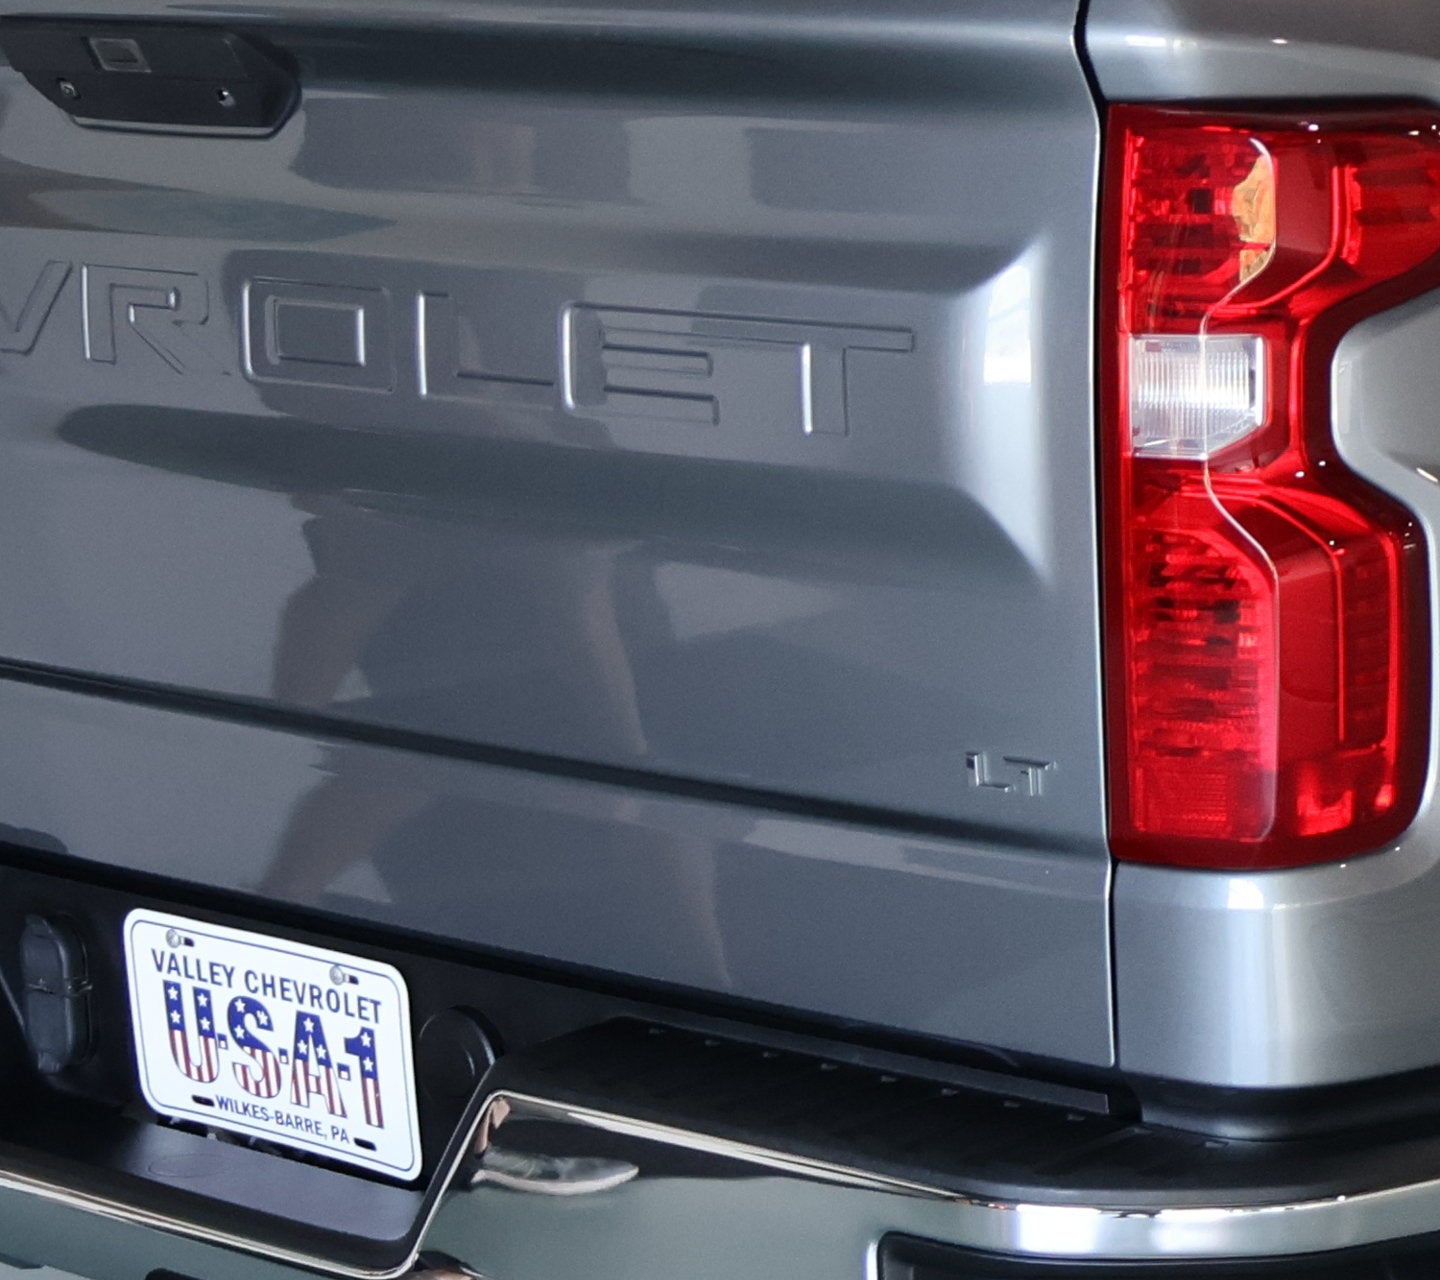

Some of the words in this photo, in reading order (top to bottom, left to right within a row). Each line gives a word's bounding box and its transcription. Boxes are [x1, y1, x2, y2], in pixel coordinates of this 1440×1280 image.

[966, 751, 1057, 796] LT
[151, 948, 235, 988] VALLEY
[245, 970, 382, 1024] CHEVROLET
[215, 1094, 328, 1140] WILKES-BARRE,
[332, 1127, 350, 1144] PA
